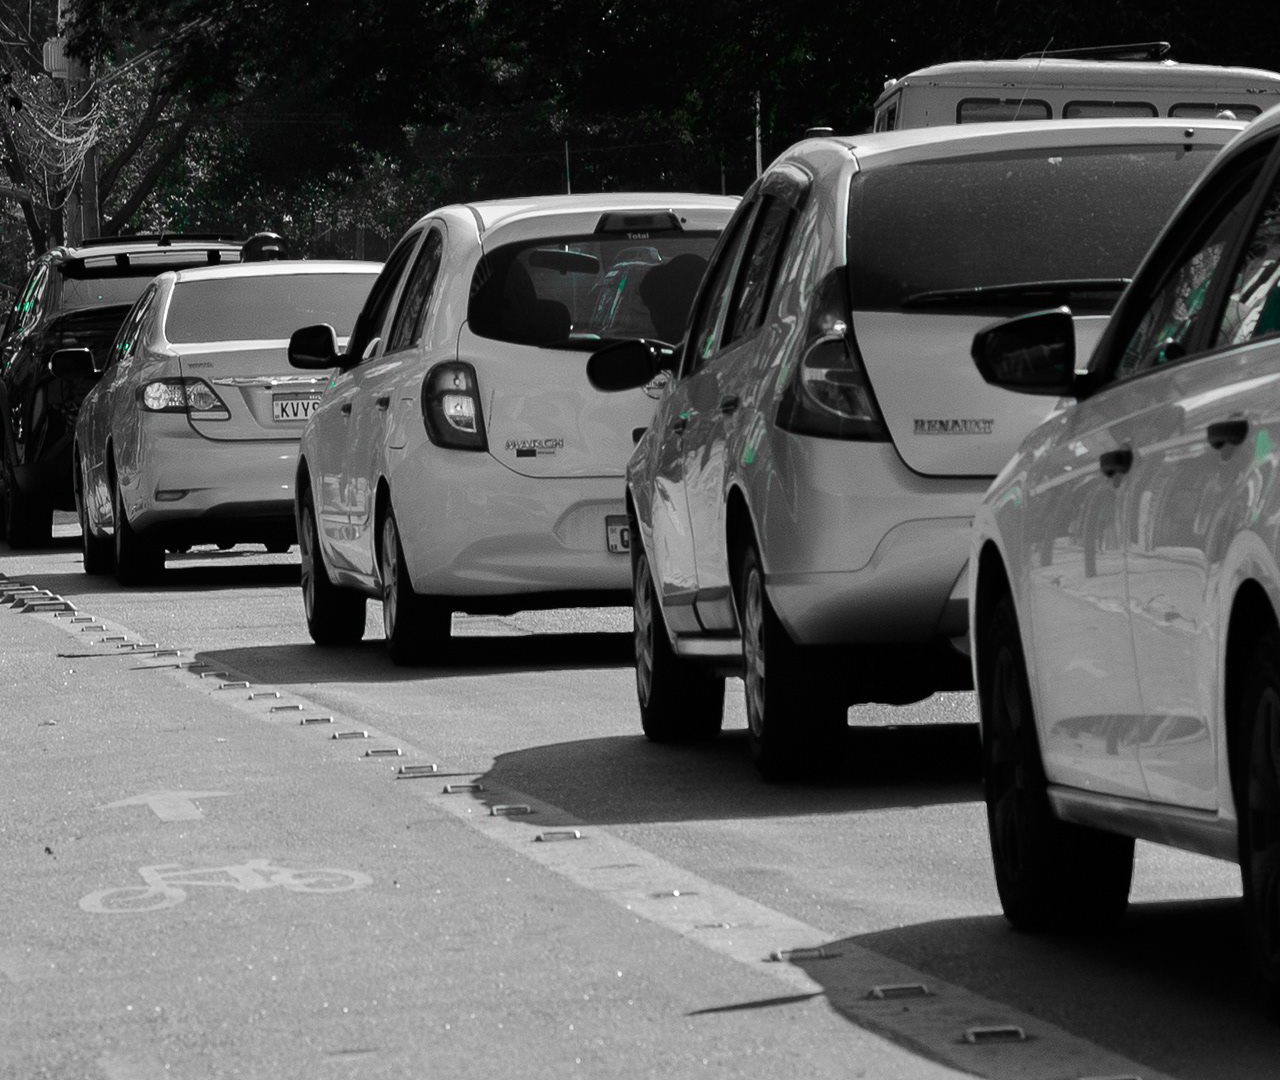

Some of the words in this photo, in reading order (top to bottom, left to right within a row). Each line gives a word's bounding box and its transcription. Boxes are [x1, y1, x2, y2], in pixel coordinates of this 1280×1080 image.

[626, 232, 649, 240] Total
[914, 419, 994, 435] RENAULT
[505, 439, 565, 451] MARCH
